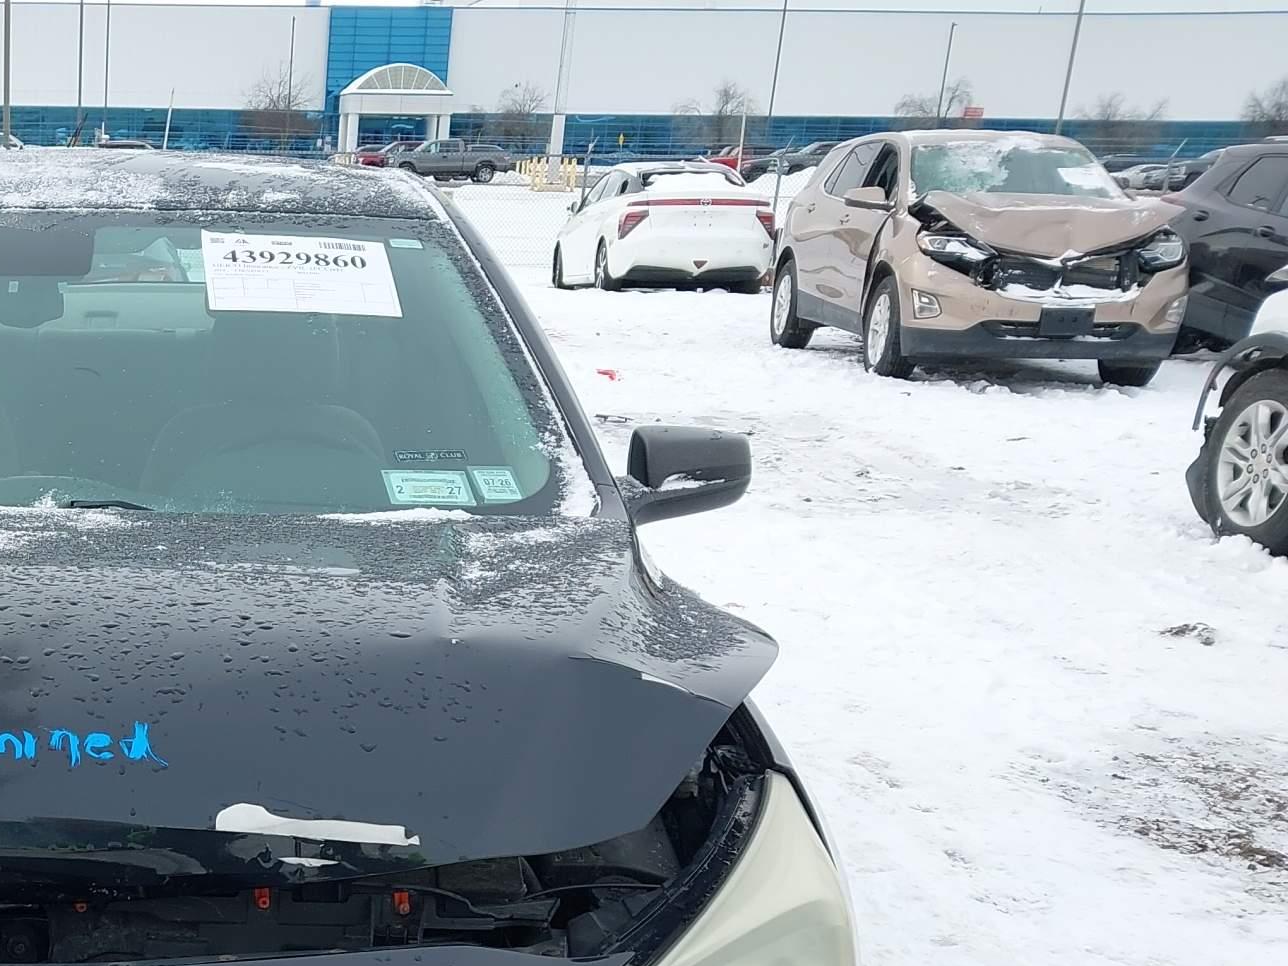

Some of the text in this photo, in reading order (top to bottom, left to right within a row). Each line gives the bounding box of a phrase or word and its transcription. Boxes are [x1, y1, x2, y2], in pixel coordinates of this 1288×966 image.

[223, 249, 367, 269] 43929860
[398, 451, 463, 460] ROYAL CLUB
[395, 485, 462, 496] 2 27
